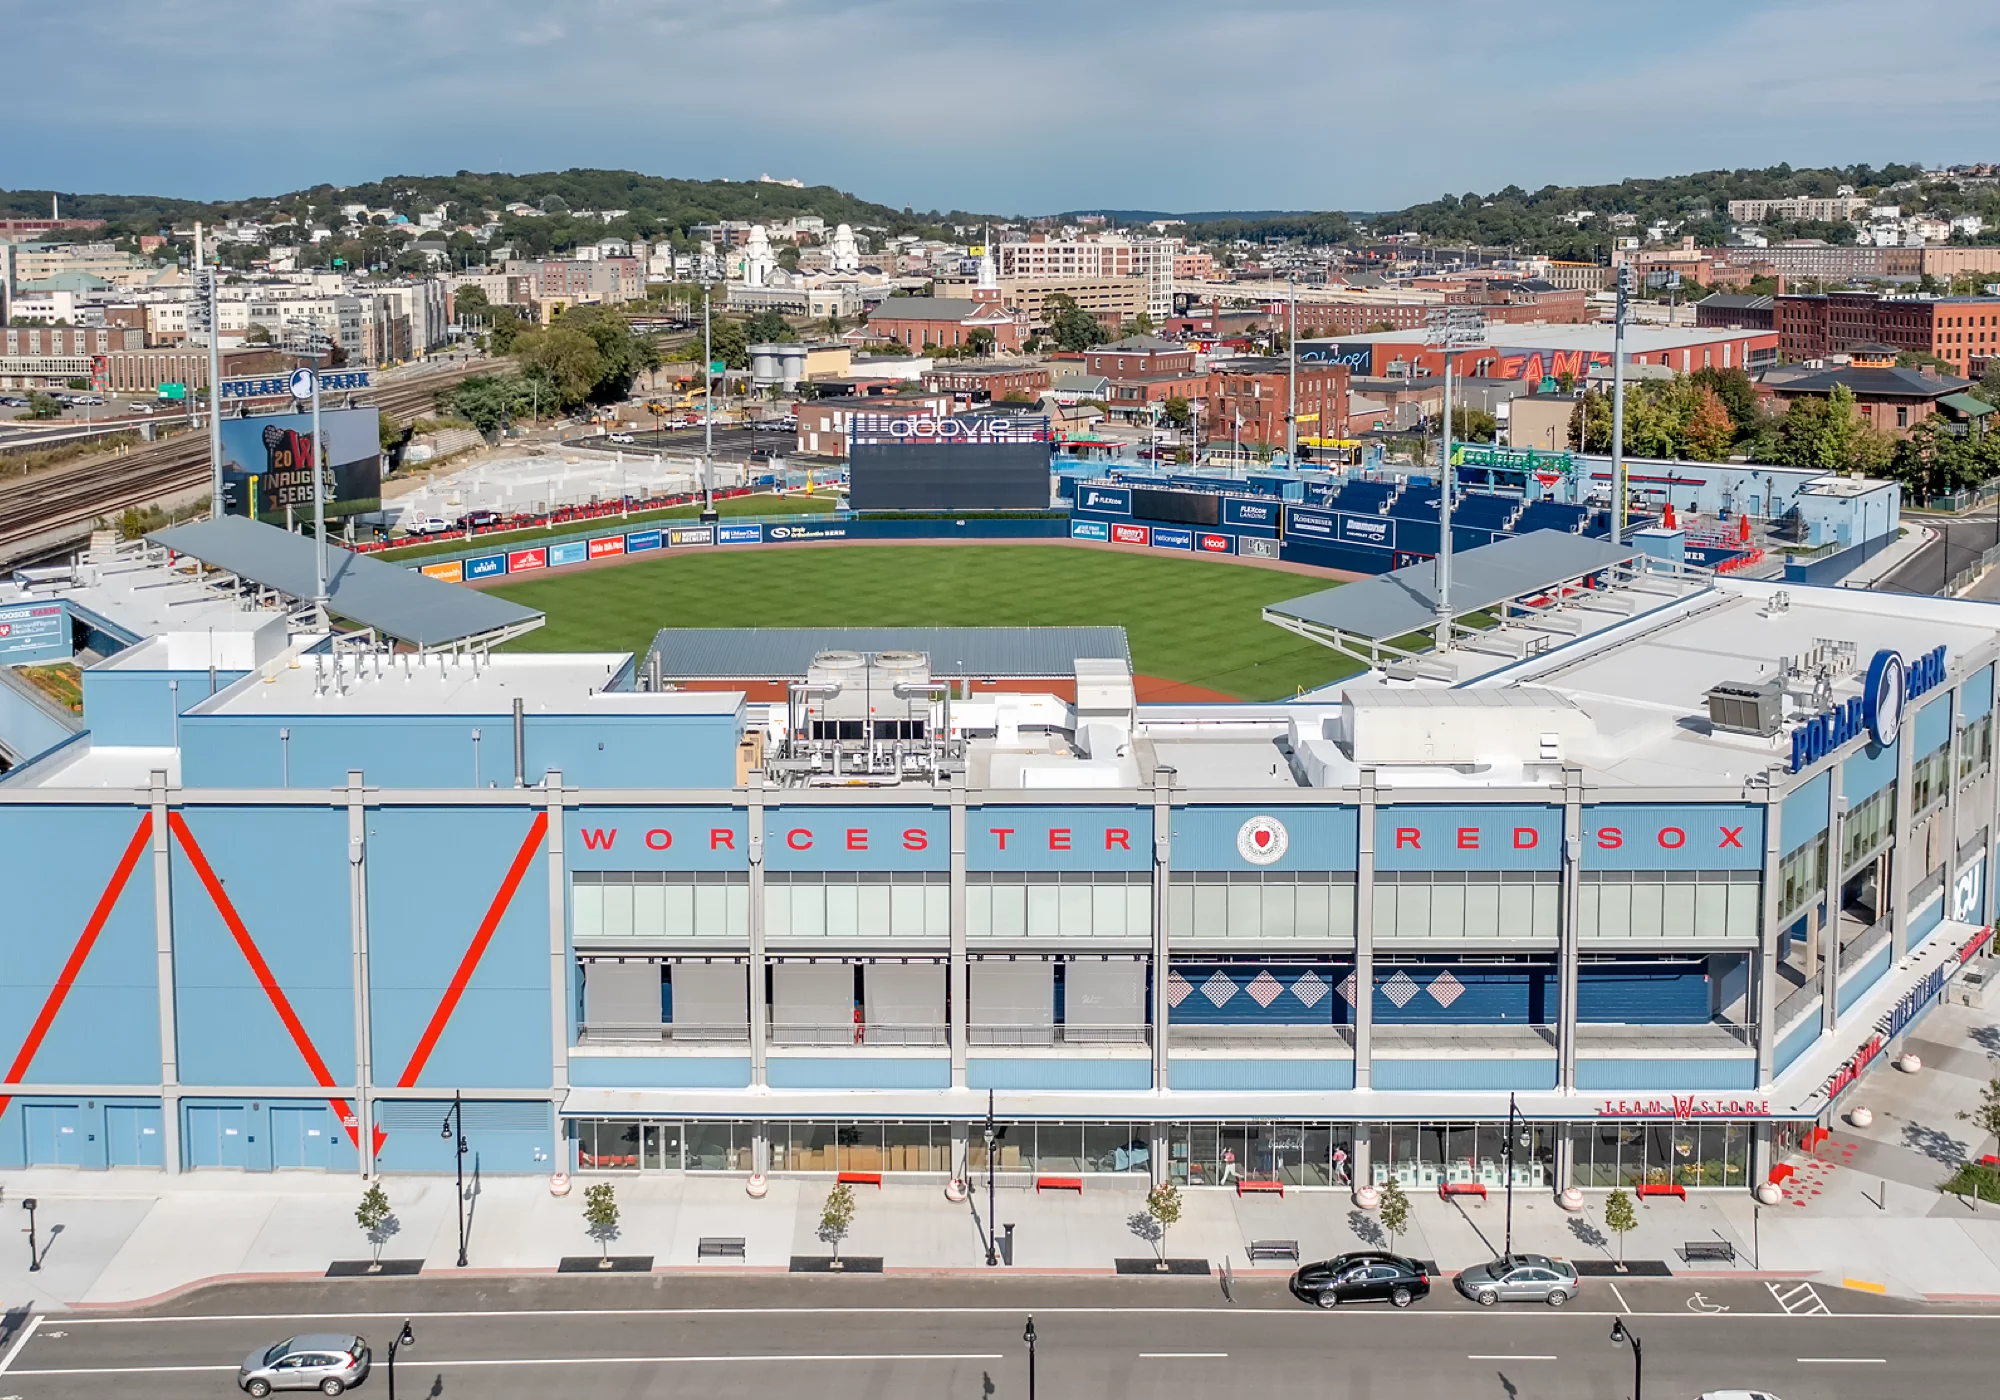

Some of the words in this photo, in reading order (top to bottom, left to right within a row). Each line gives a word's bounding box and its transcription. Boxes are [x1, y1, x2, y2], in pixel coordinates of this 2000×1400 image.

[221, 378, 284, 398] POLAR
[321, 372, 370, 391] PARK
[889, 414, 1011, 438] abbvie
[1155, 534, 1189, 545] nationalgrid
[1204, 538, 1226, 548] Hood
[1792, 695, 1864, 774] POLAR
[1903, 644, 1947, 701] PARK
[580, 826, 1133, 851] WORCESTER
[1395, 826, 1539, 850] RED
[1596, 825, 1745, 849] SOX
[1605, 1100, 1662, 1113] TEAM
[1701, 1100, 1769, 1113] STORE
